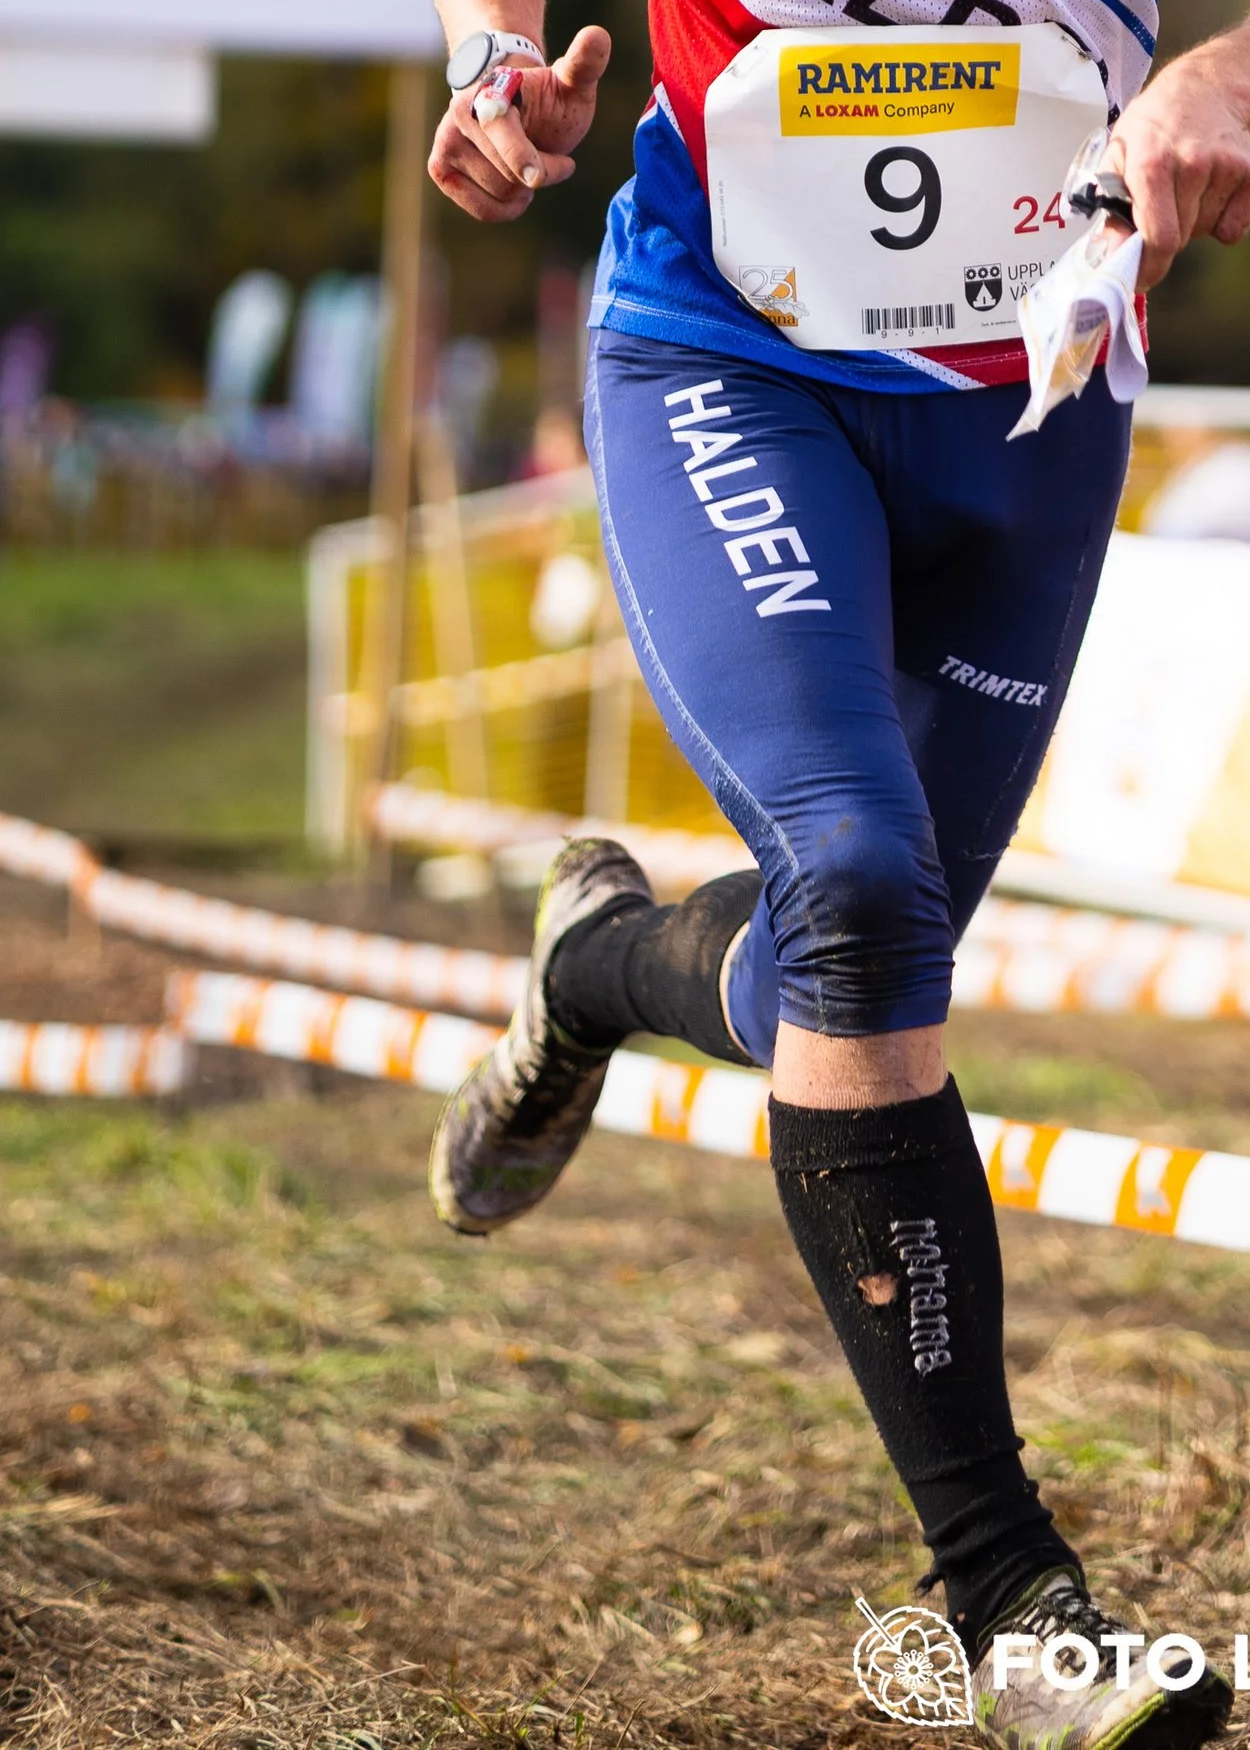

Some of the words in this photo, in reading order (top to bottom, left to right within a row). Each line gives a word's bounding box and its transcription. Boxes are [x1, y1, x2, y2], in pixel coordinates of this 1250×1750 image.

[797, 61, 1001, 94] RAMIRENT
[800, 105, 811, 117] A
[816, 104, 879, 117] LOXAM
[884, 102, 955, 118] Company
[864, 146, 942, 250] 9
[743, 268, 793, 300] 25
[664, 379, 832, 618] HALDEN
[939, 655, 1048, 707] TRIMTEX
